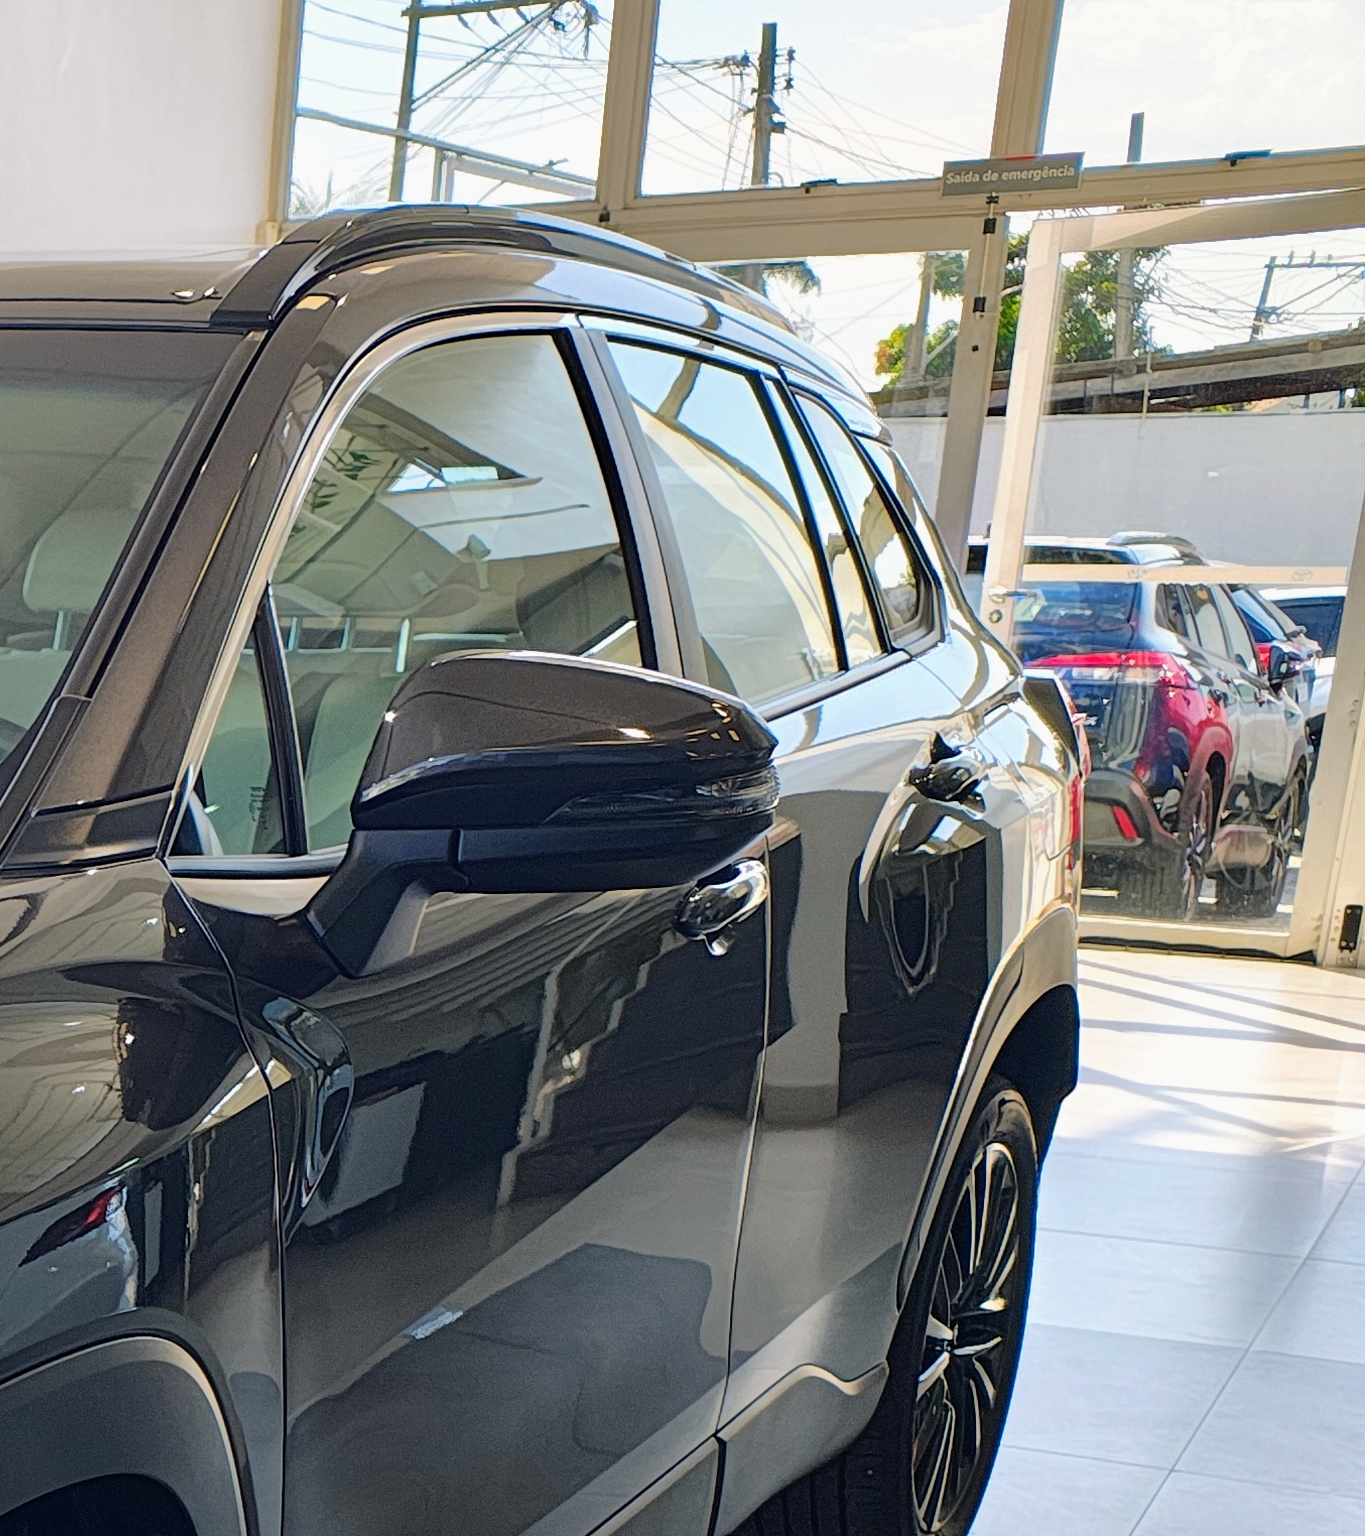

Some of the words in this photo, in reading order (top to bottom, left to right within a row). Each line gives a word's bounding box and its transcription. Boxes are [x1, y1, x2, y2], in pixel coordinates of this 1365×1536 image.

[946, 170, 980, 184] Saída
[983, 170, 999, 181] de
[1002, 165, 1075, 182] emergência
